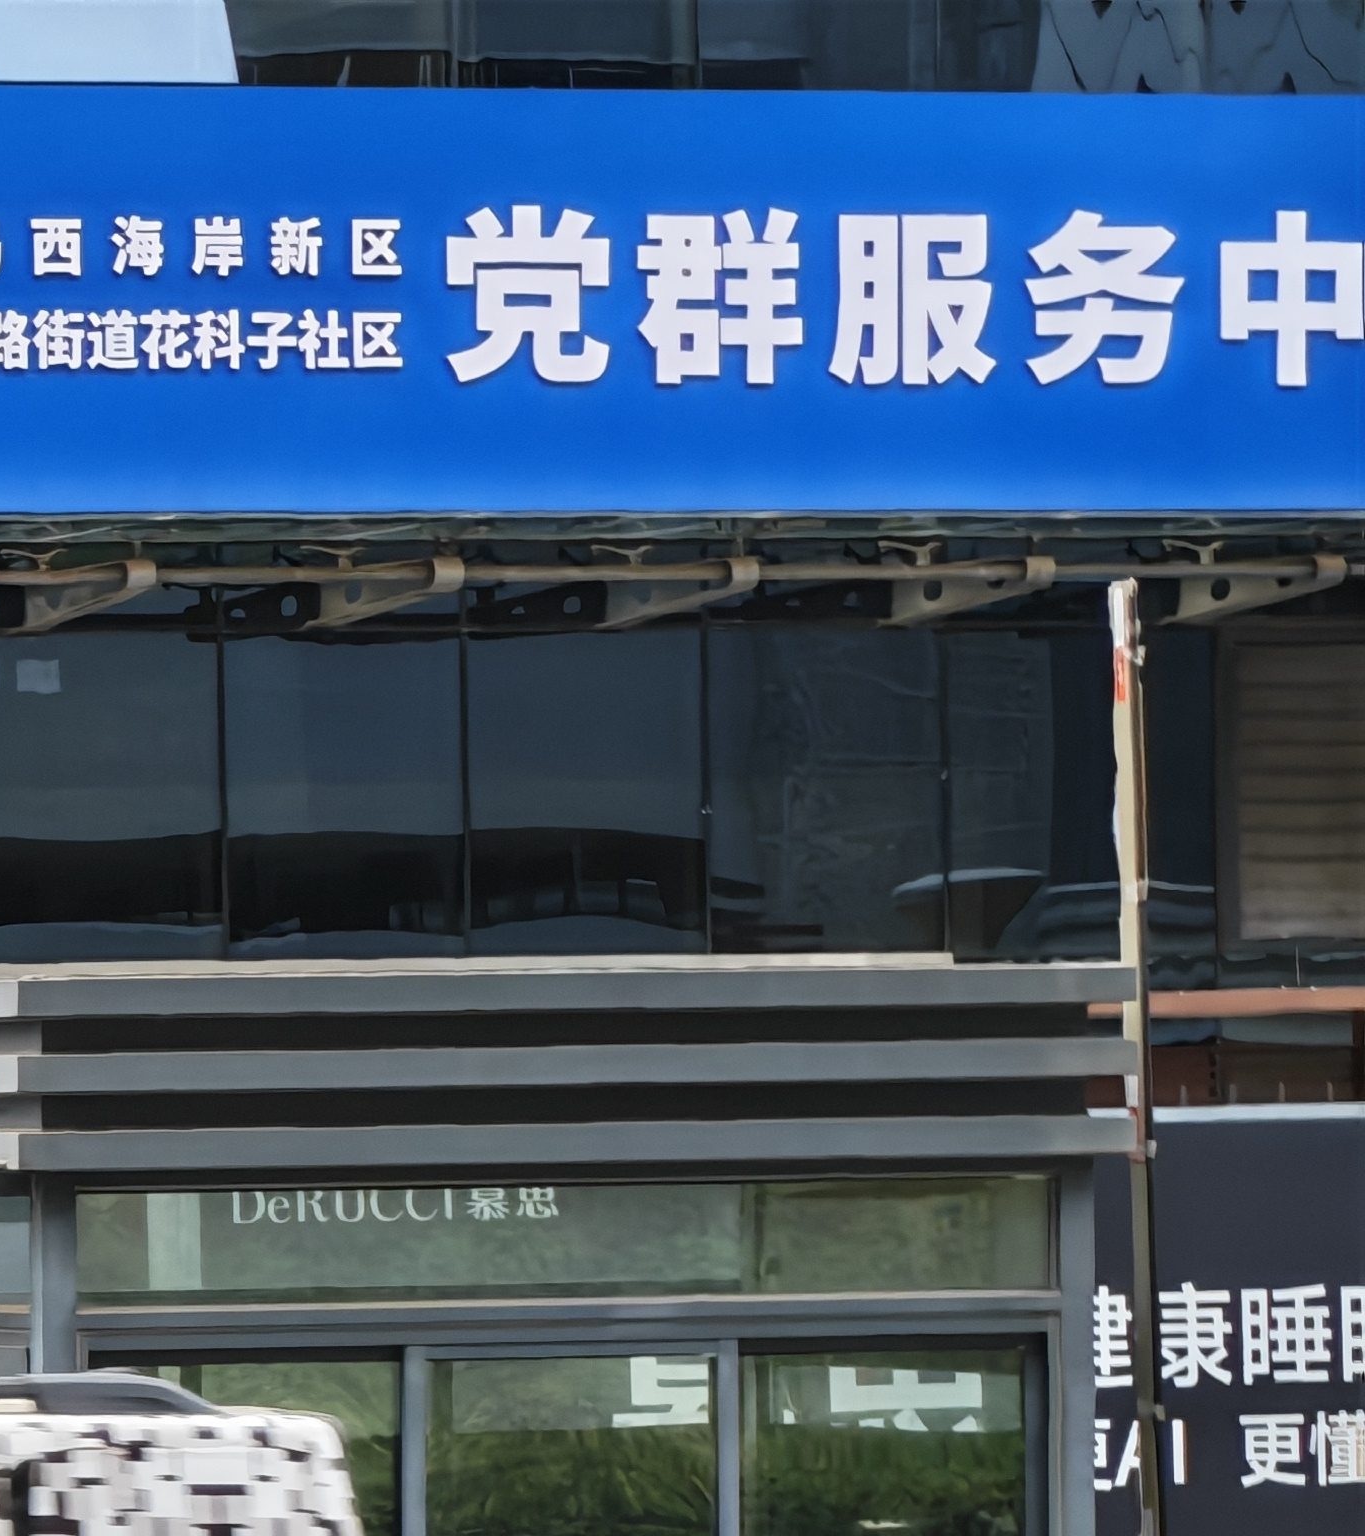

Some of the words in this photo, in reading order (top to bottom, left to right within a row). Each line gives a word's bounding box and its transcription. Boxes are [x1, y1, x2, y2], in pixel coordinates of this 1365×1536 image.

[446, 205, 1365, 387] 党群服务中
[232, 1188, 453, 1224] DeRUCCI
[1094, 1419, 1187, 1491] AI
